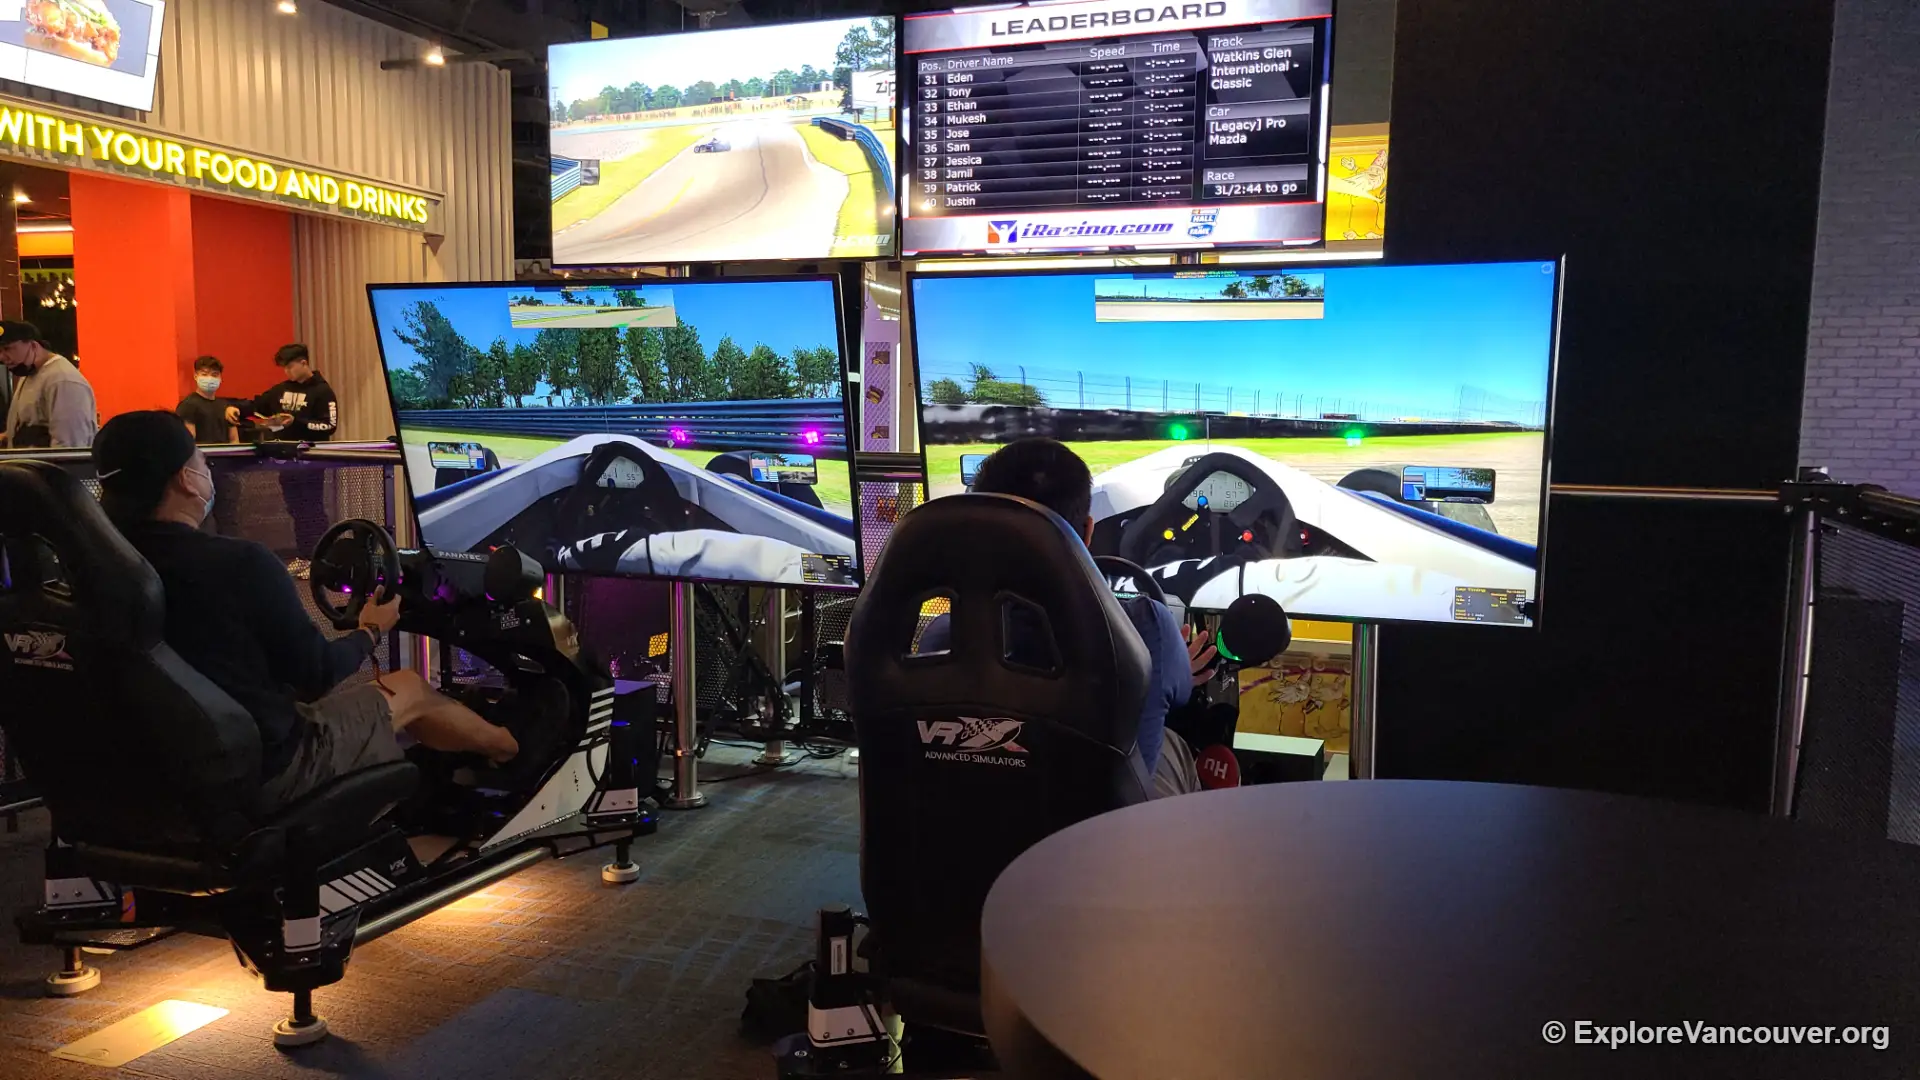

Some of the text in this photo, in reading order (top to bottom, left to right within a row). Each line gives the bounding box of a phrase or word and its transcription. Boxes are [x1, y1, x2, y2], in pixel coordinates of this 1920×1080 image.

[992, 1, 1226, 37] LEADERBOARD
[1211, 36, 1243, 48] Track
[921, 42, 1180, 71] Pos. Driver Name Speed Time
[1212, 47, 1292, 63] Watkins Glen
[1211, 60, 1290, 77] International
[924, 75, 938, 85] 31
[947, 73, 973, 84] Eden
[1211, 77, 1252, 90] Classic
[924, 89, 938, 98] 32
[946, 88, 972, 98] Tony
[924, 103, 938, 112] 33
[947, 101, 977, 111] Ethan
[1209, 107, 1230, 116] Car
[924, 116, 938, 126] 34
[947, 114, 986, 125] Mukesh
[1210, 118, 1286, 134] [Legacy] Pro
[924, 130, 938, 140] 35
[946, 128, 969, 139] Jose
[1209, 133, 1247, 145] Mazda
[924, 144, 938, 153] 36
[946, 143, 970, 152] Sam
[0, 106, 428, 224] WITH YOUR FOOD AND DRINKS
[924, 158, 938, 167] 37
[946, 156, 982, 167] Jessica
[924, 170, 938, 180] 38
[946, 169, 973, 179] Jamil
[1207, 171, 1235, 181] Race
[924, 184, 937, 193] 39
[946, 182, 981, 192] Patrick
[1215, 183, 1297, 196] 3L/2:44 to go
[946, 197, 976, 207] Justin
[1022, 221, 1174, 237] iRacing.com
[438, 551, 482, 561] FANATEC
[925, 751, 1026, 768] ADVANCED SIMULATORS
